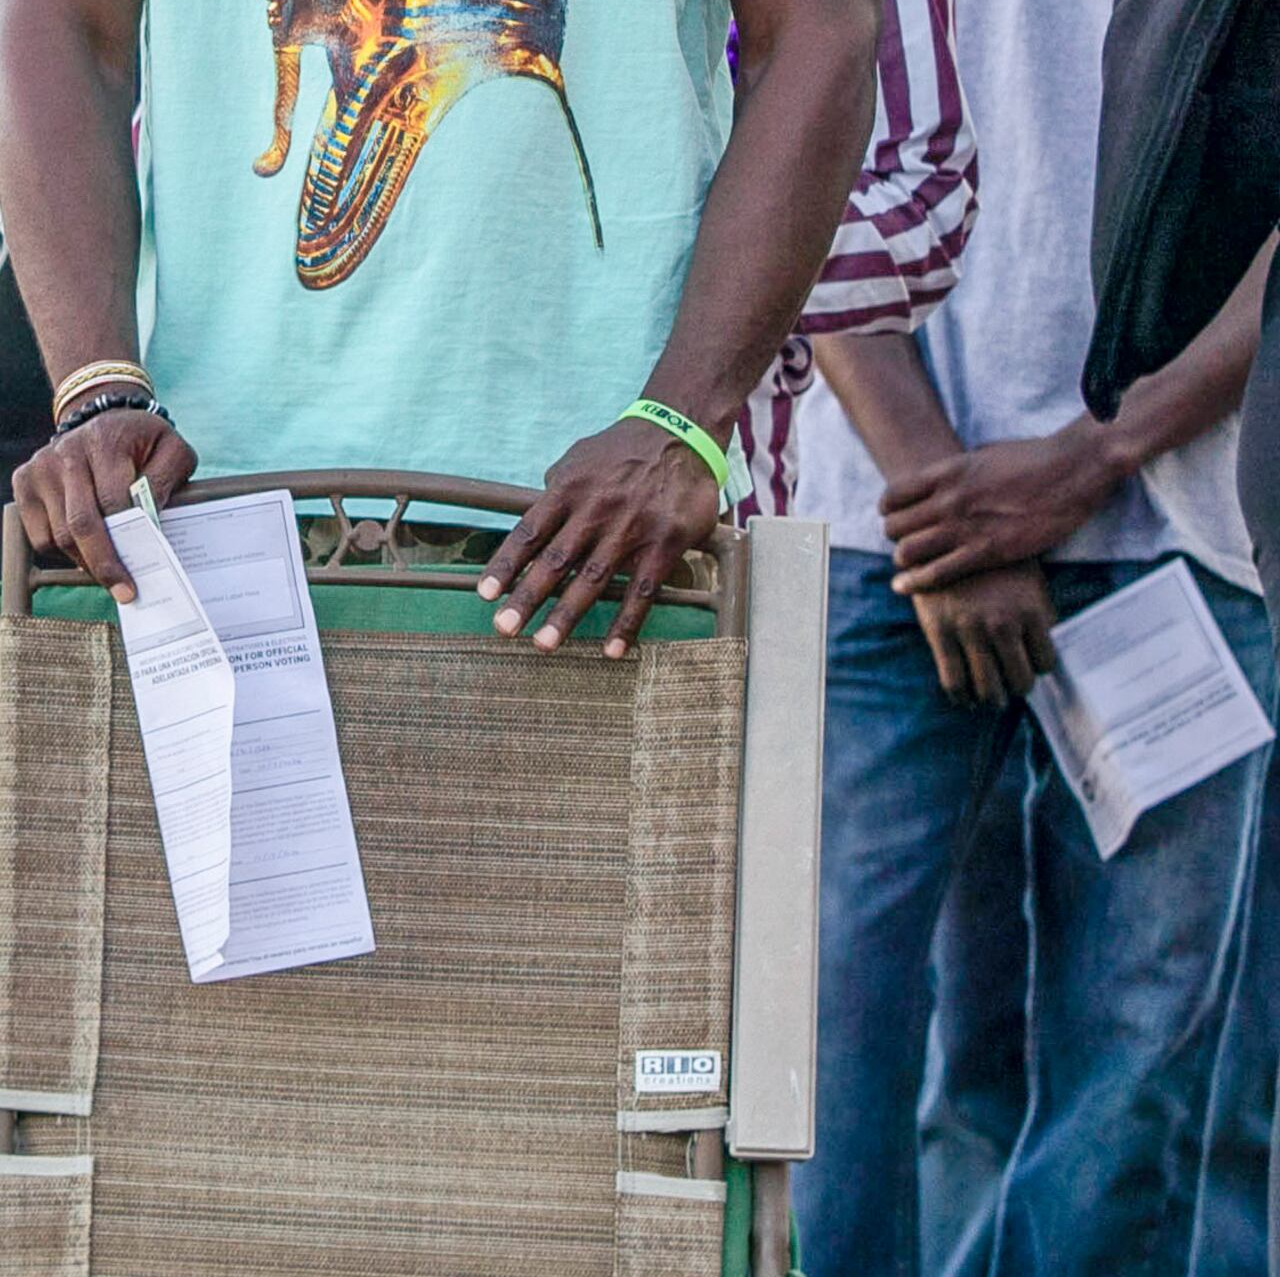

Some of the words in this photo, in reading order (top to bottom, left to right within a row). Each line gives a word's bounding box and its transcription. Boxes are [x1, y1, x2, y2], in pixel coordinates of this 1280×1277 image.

[640, 403, 693, 433] ICEBOX
[245, 650, 263, 661] FOR
[266, 643, 308, 658] OFFICIAL
[234, 661, 272, 673] PERSON
[275, 653, 311, 666] VOTING
[641, 1056, 715, 1074] RIO
